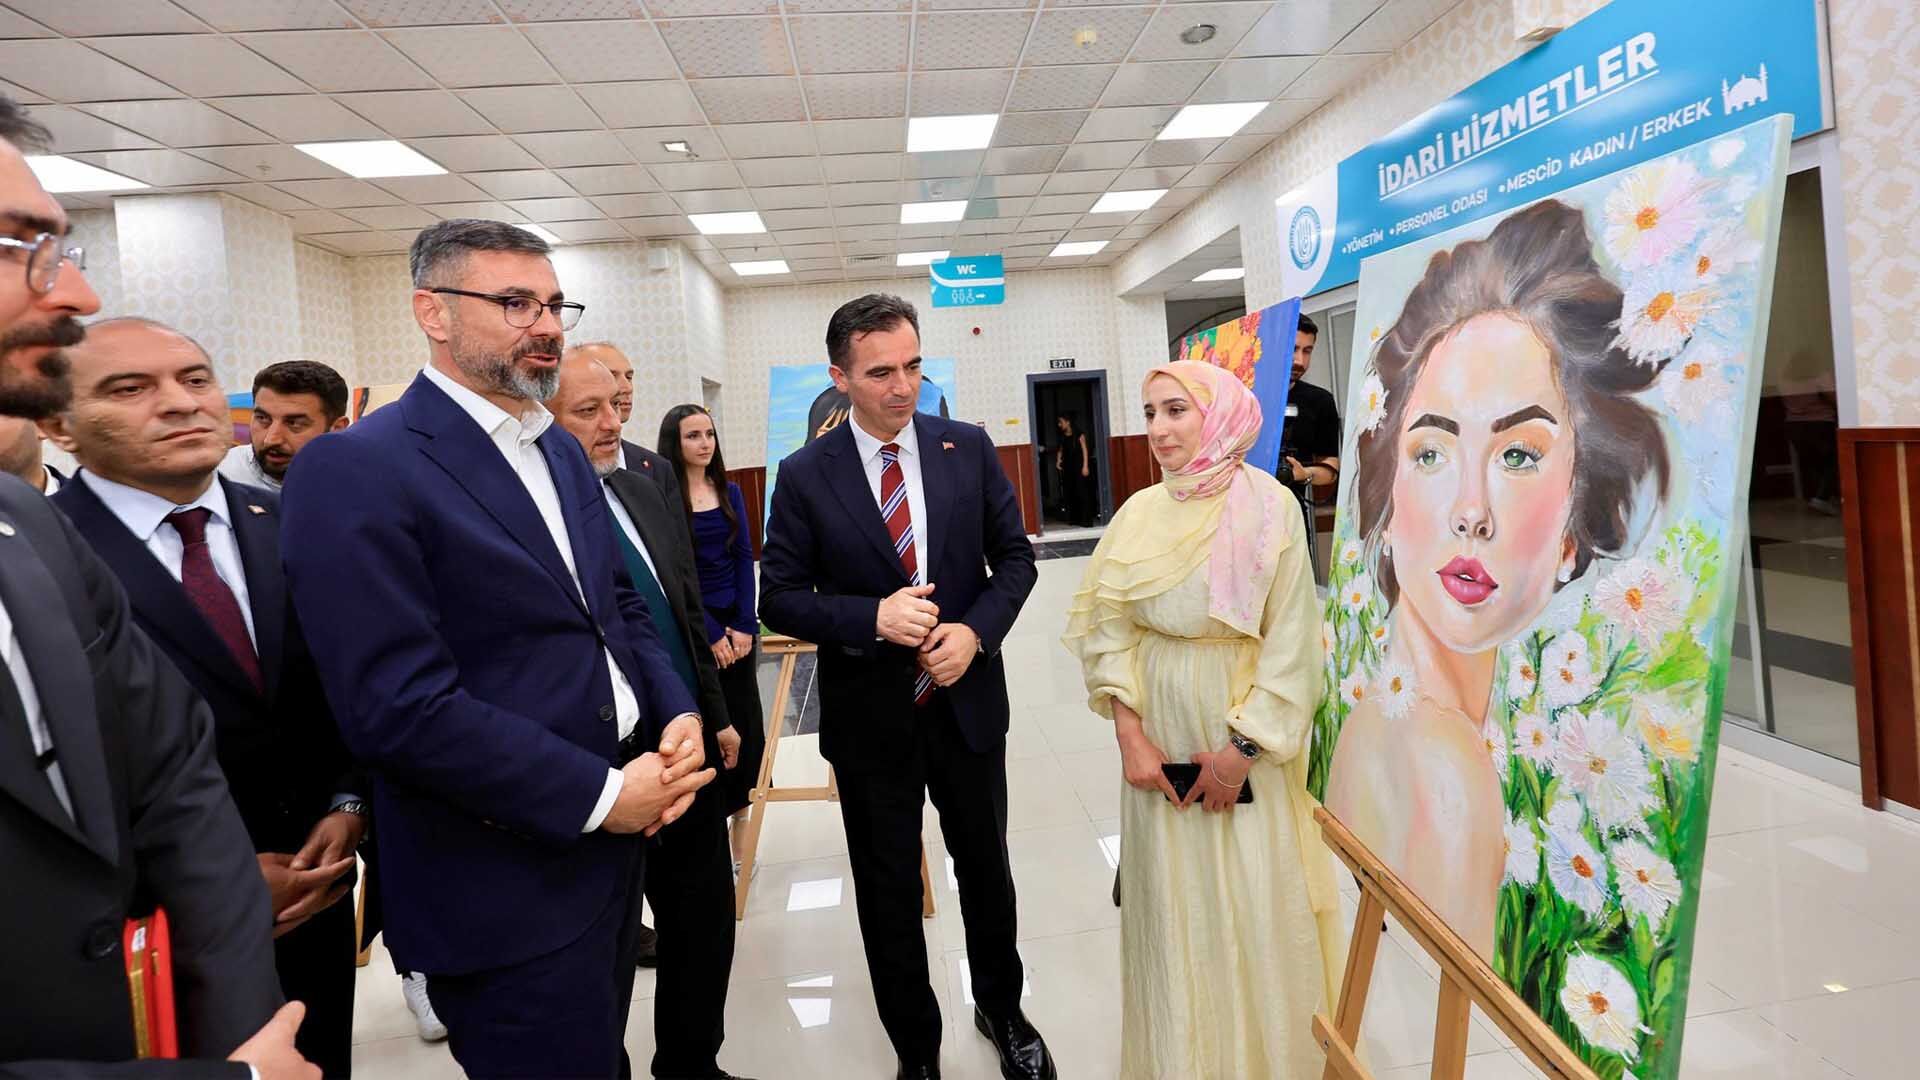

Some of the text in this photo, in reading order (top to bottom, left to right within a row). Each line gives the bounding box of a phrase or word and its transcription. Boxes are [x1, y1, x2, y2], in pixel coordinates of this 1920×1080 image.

[1378, 32, 1658, 196] İDARİ HİZMETLER
[1569, 132, 1625, 169] KADIN
[1628, 126, 1637, 151] /
[1641, 97, 1713, 142] ERKEK
[956, 264, 977, 274] WC
[1052, 360, 1073, 368] EXIT
